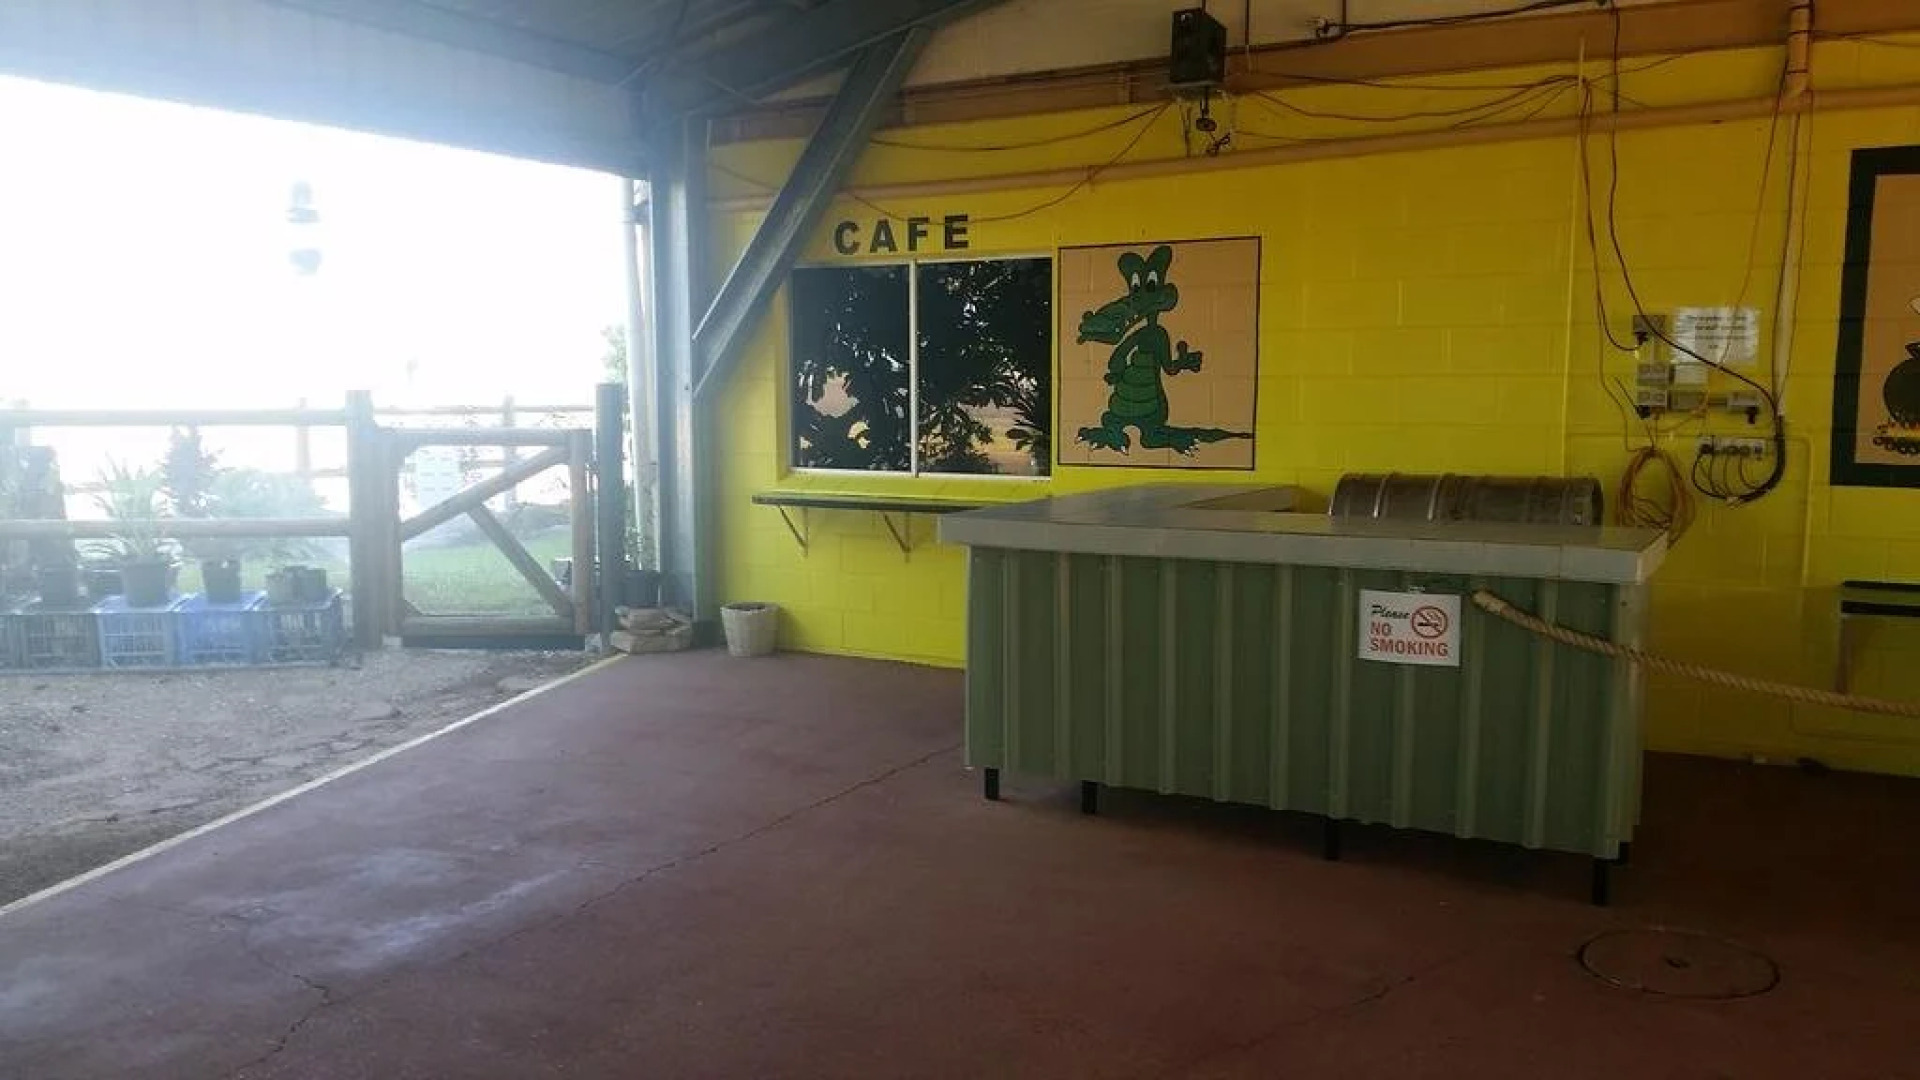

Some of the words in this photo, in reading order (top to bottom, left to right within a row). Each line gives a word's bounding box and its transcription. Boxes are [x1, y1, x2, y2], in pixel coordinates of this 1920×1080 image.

[834, 214, 970, 255] CAFE
[1371, 604, 1411, 619] Please
[1370, 621, 1392, 636] NO
[1370, 638, 1449, 657] SMOKING
